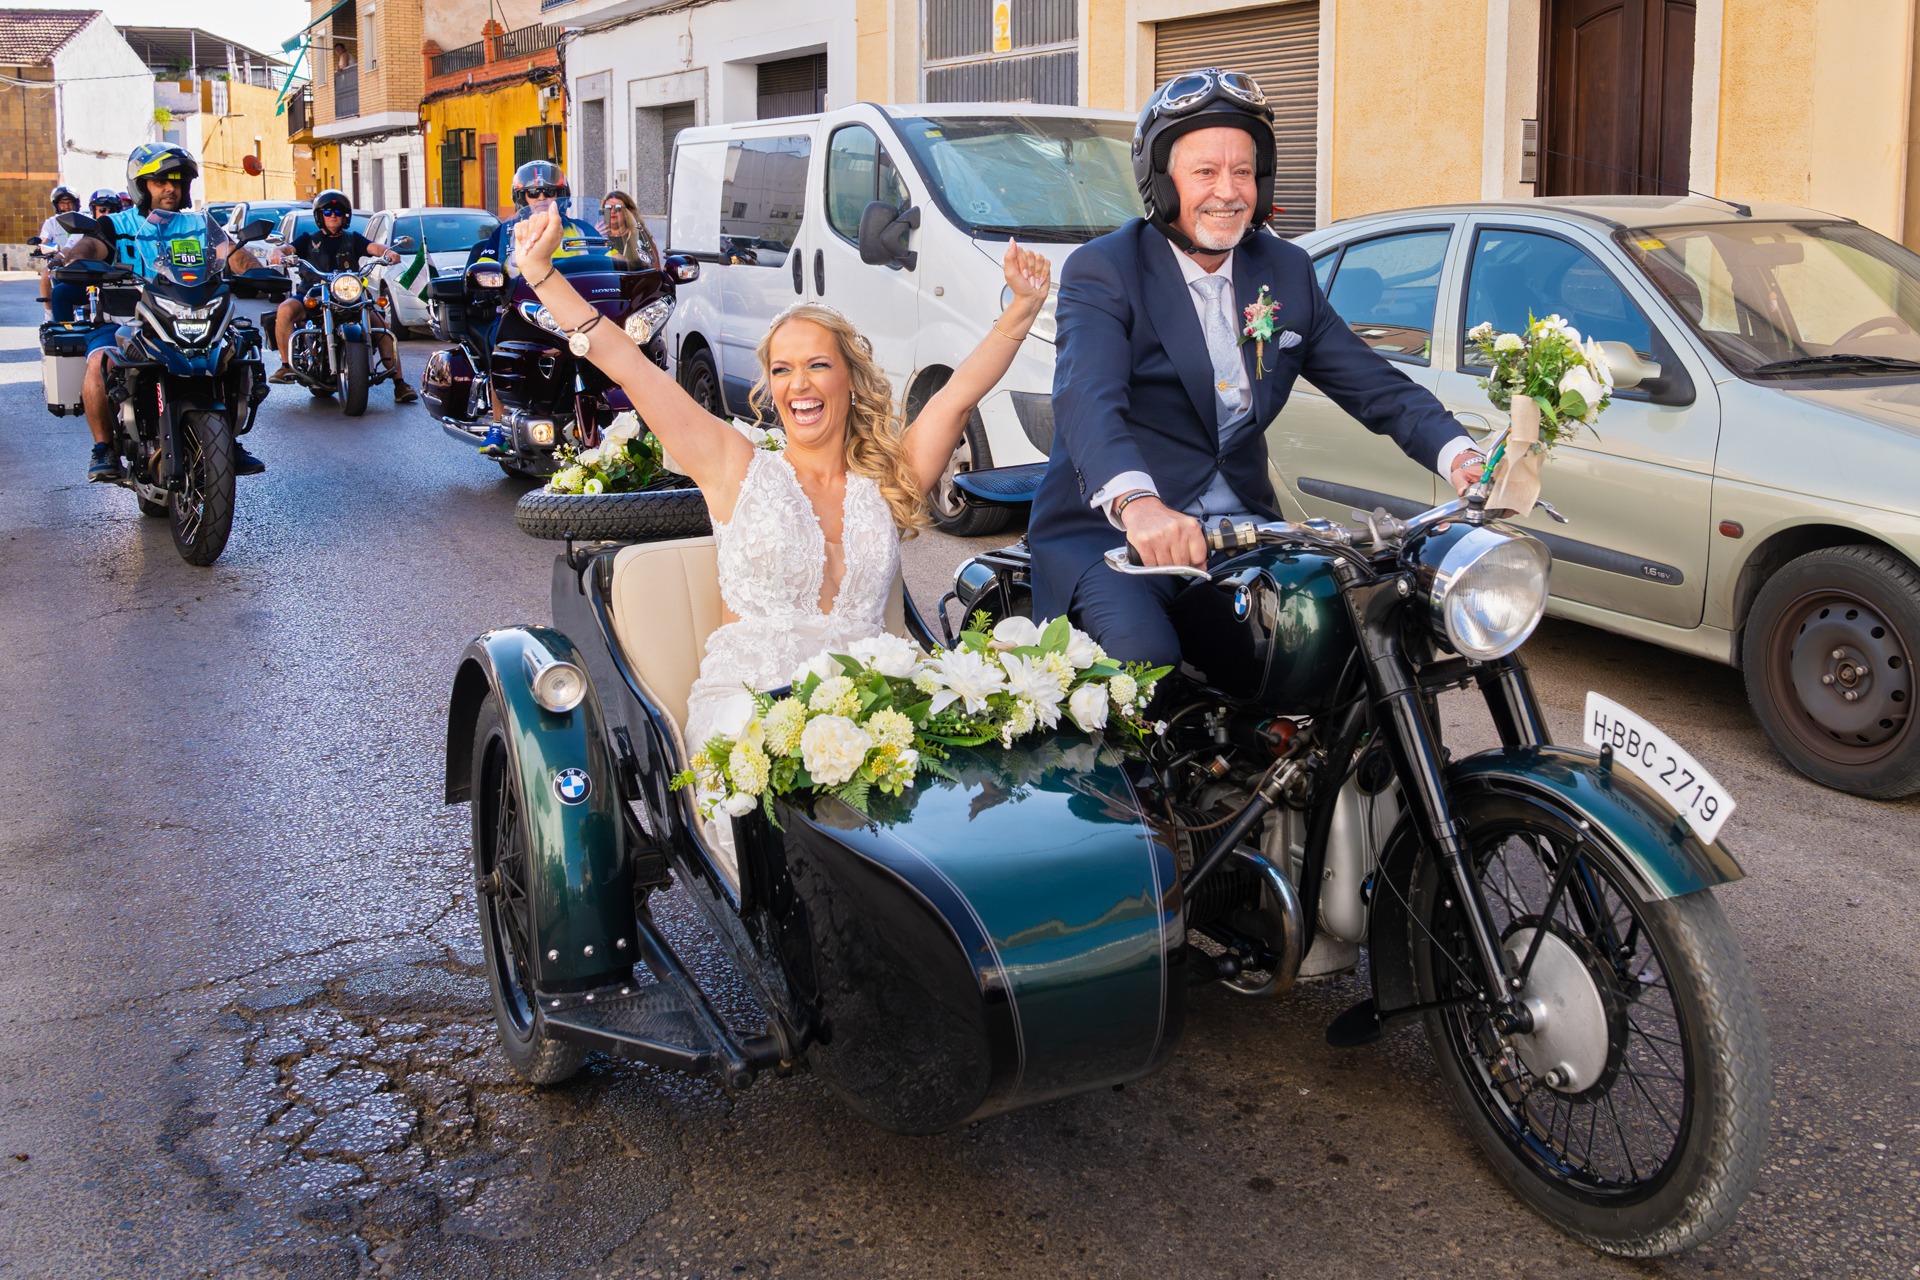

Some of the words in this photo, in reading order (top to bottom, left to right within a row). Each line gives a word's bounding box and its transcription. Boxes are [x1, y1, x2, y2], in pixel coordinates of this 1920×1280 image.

[1643, 566, 1657, 577] 1.6
[1593, 710, 1657, 768] H-BBC
[1659, 756, 1719, 822] 2719
[556, 769, 587, 783] BMW
